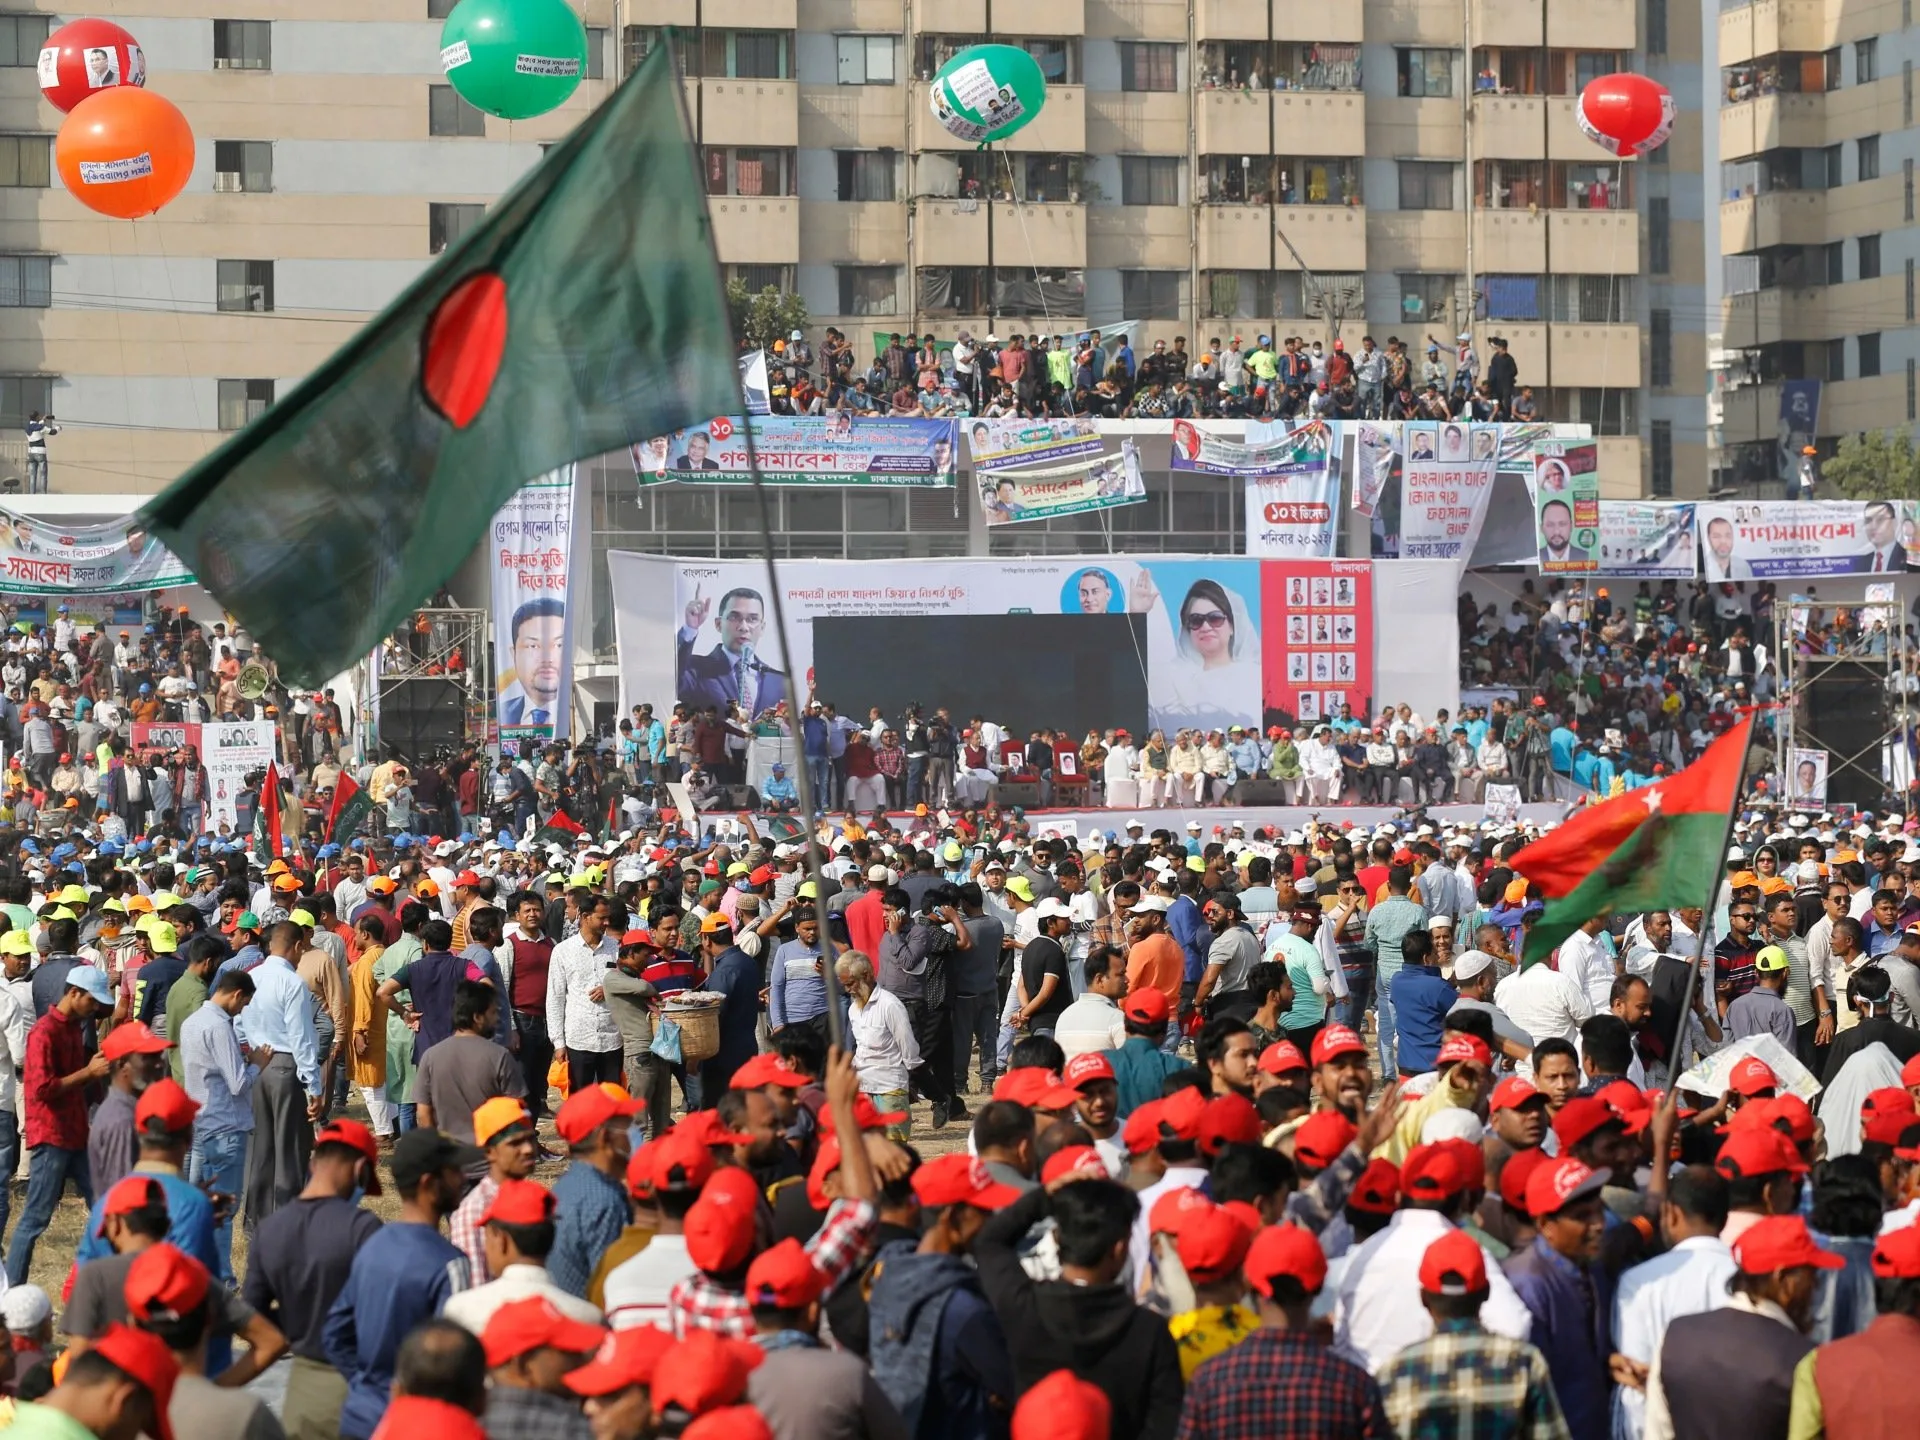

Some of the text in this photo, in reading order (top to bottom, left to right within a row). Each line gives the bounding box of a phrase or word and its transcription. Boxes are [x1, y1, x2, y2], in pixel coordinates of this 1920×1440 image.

[83, 169, 129, 183] মুজিববাদের
[711, 421, 731, 436] ১০
[719, 450, 837, 469] গণসমাবেশ
[1206, 463, 1231, 474] ঢাকা
[870, 474, 890, 484] ঢাকা
[891, 475, 922, 485] মহানগর
[1409, 470, 1488, 487] বাংলাদেশ যাবে
[1020, 477, 1084, 497] সমাবেশ
[1408, 490, 1459, 506] কোন পথে
[1272, 504, 1329, 521] ১০ ই ডিসেম্বর
[1426, 507, 1472, 524] ফয়সালা
[495, 521, 520, 542] বেগম
[522, 520, 553, 541] খালেদা
[1260, 529, 1294, 545] শনিবার
[1739, 522, 1856, 543] গণসমাবেশ
[46, 546, 116, 559] ঢাকা বিভাগীয়
[1406, 541, 1432, 557] জনাব
[1433, 541, 1462, 557] তারেক
[1770, 546, 1795, 556] সফল
[500, 547, 565, 571] নিঃশর্ত মুক্তি
[73, 567, 96, 582] সফল
[97, 564, 116, 581] হোক
[682, 567, 720, 579] বাংলাদেশ
[1330, 561, 1370, 574] জিন্দাবাদ
[518, 570, 567, 591] দিতে হবে
[788, 586, 824, 600] দেশনেত্রী
[827, 588, 849, 600] বেগম
[852, 588, 882, 600] খালেদা
[919, 585, 945, 599] নিঃশর্ত
[948, 586, 965, 600] মুক্তি
